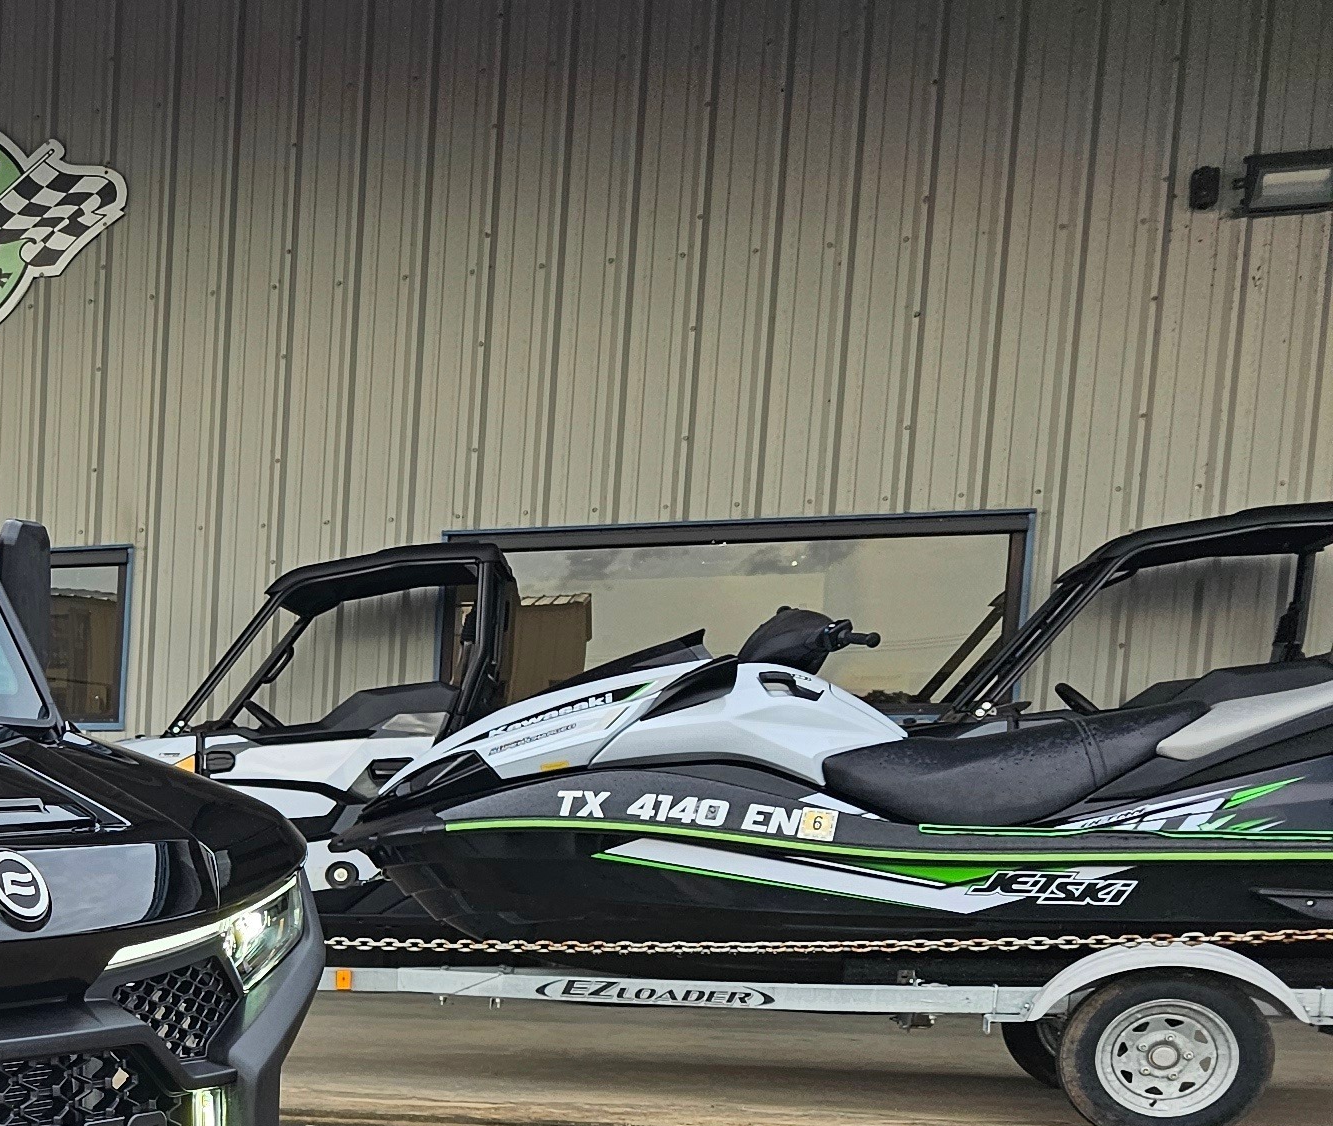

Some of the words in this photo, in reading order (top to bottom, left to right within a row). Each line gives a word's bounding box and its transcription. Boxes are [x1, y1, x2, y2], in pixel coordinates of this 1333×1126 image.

[488, 692, 614, 739] Kawasaki
[556, 790, 611, 818] TX
[626, 793, 731, 827] 4140
[740, 803, 804, 836] EN
[812, 815, 824, 831] 6
